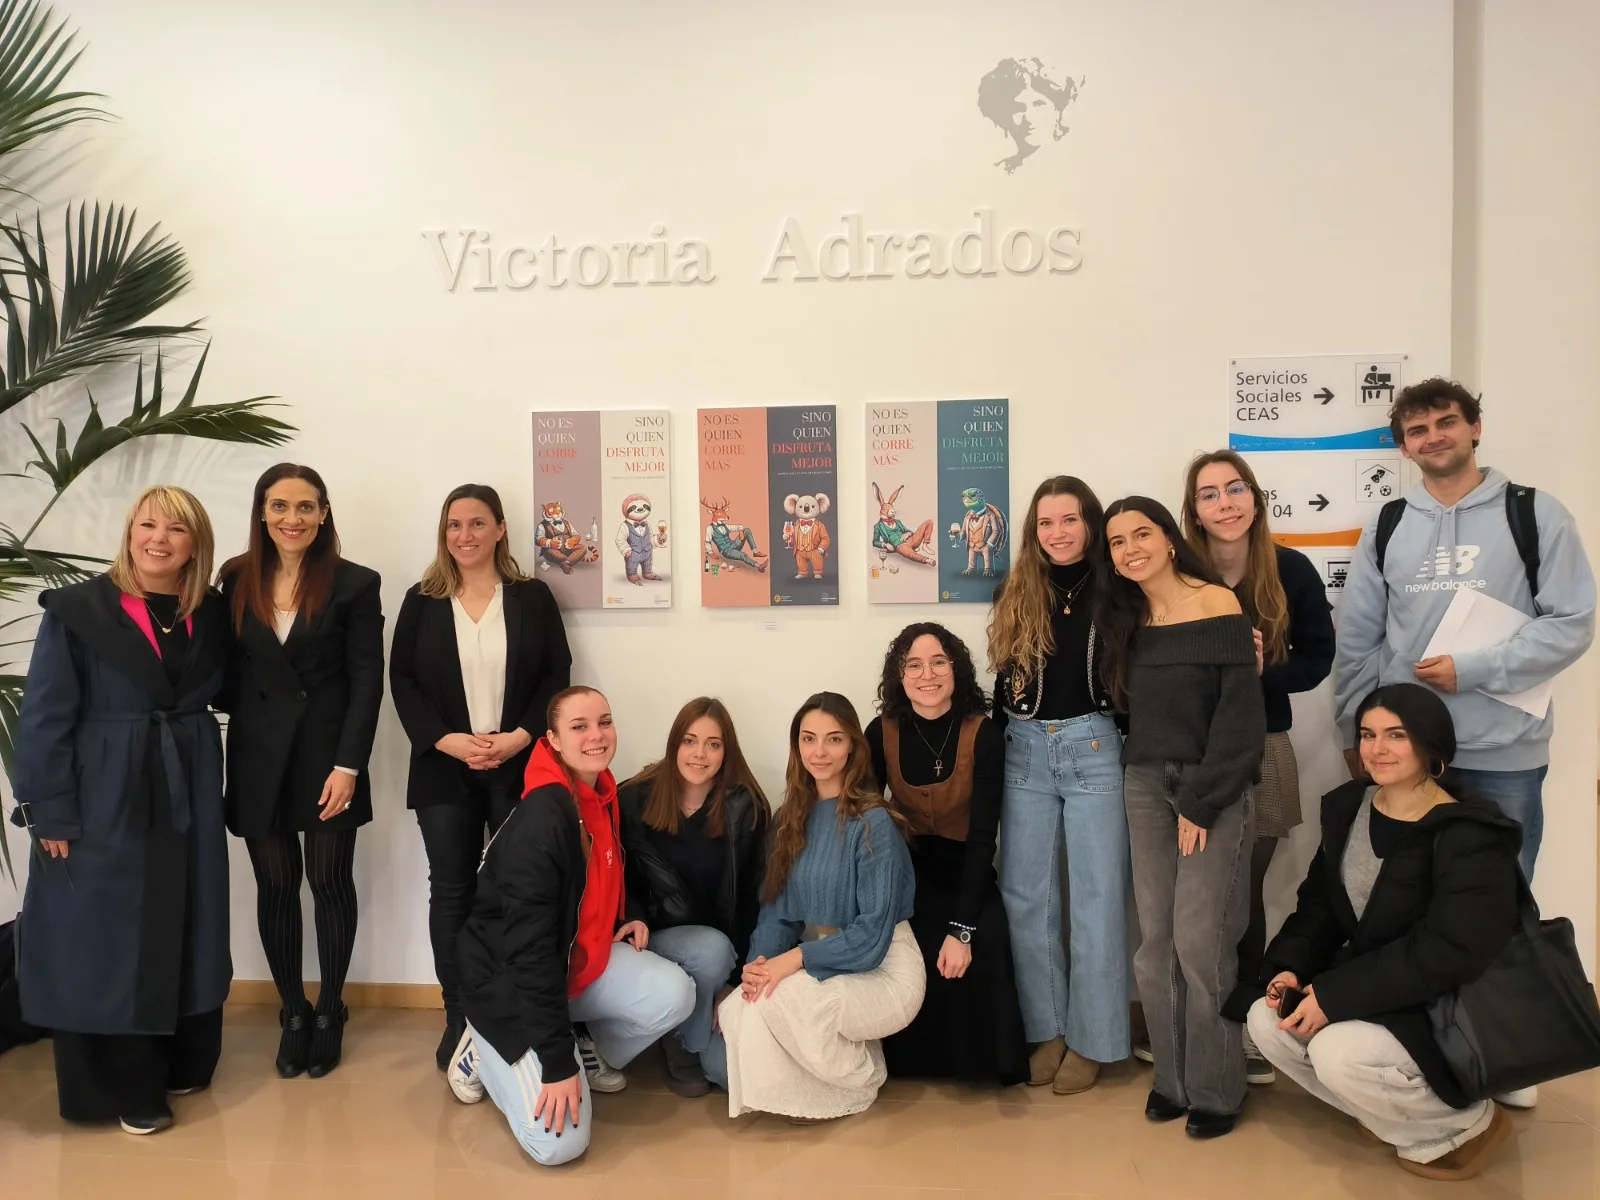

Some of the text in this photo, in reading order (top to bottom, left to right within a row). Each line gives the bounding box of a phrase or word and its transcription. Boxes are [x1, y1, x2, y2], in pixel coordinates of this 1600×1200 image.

[420, 207, 1083, 293] Victoria Adrados
[1236, 371, 1308, 385] Servicios
[1236, 388, 1302, 403] Sociales
[801, 411, 832, 423] SINO
[872, 408, 908, 420] NO ES
[973, 405, 1004, 417] SINO
[1236, 407, 1280, 421] CEAS
[538, 417, 574, 429] NO ES
[635, 416, 664, 427] SINO
[704, 414, 739, 425] NO ES
[792, 426, 832, 440] QUIEN
[872, 424, 912, 437] QUIEN
[963, 421, 1003, 434] QUIEN
[538, 433, 576, 445] QUIEN
[626, 431, 664, 444] QUIEN
[704, 429, 742, 442] QUIEN
[772, 442, 832, 454] DISFRUTA
[872, 439, 914, 450] CORRE
[942, 436, 1004, 449] DISFRUTA
[538, 448, 577, 459] CORRE
[606, 446, 665, 458] DISFRUTA
[704, 444, 745, 455] CORRE
[791, 457, 832, 469] MEJOR
[961, 451, 1004, 463] MEJOR
[625, 461, 665, 473] MEJOR
[1272, 504, 1293, 518] 04
